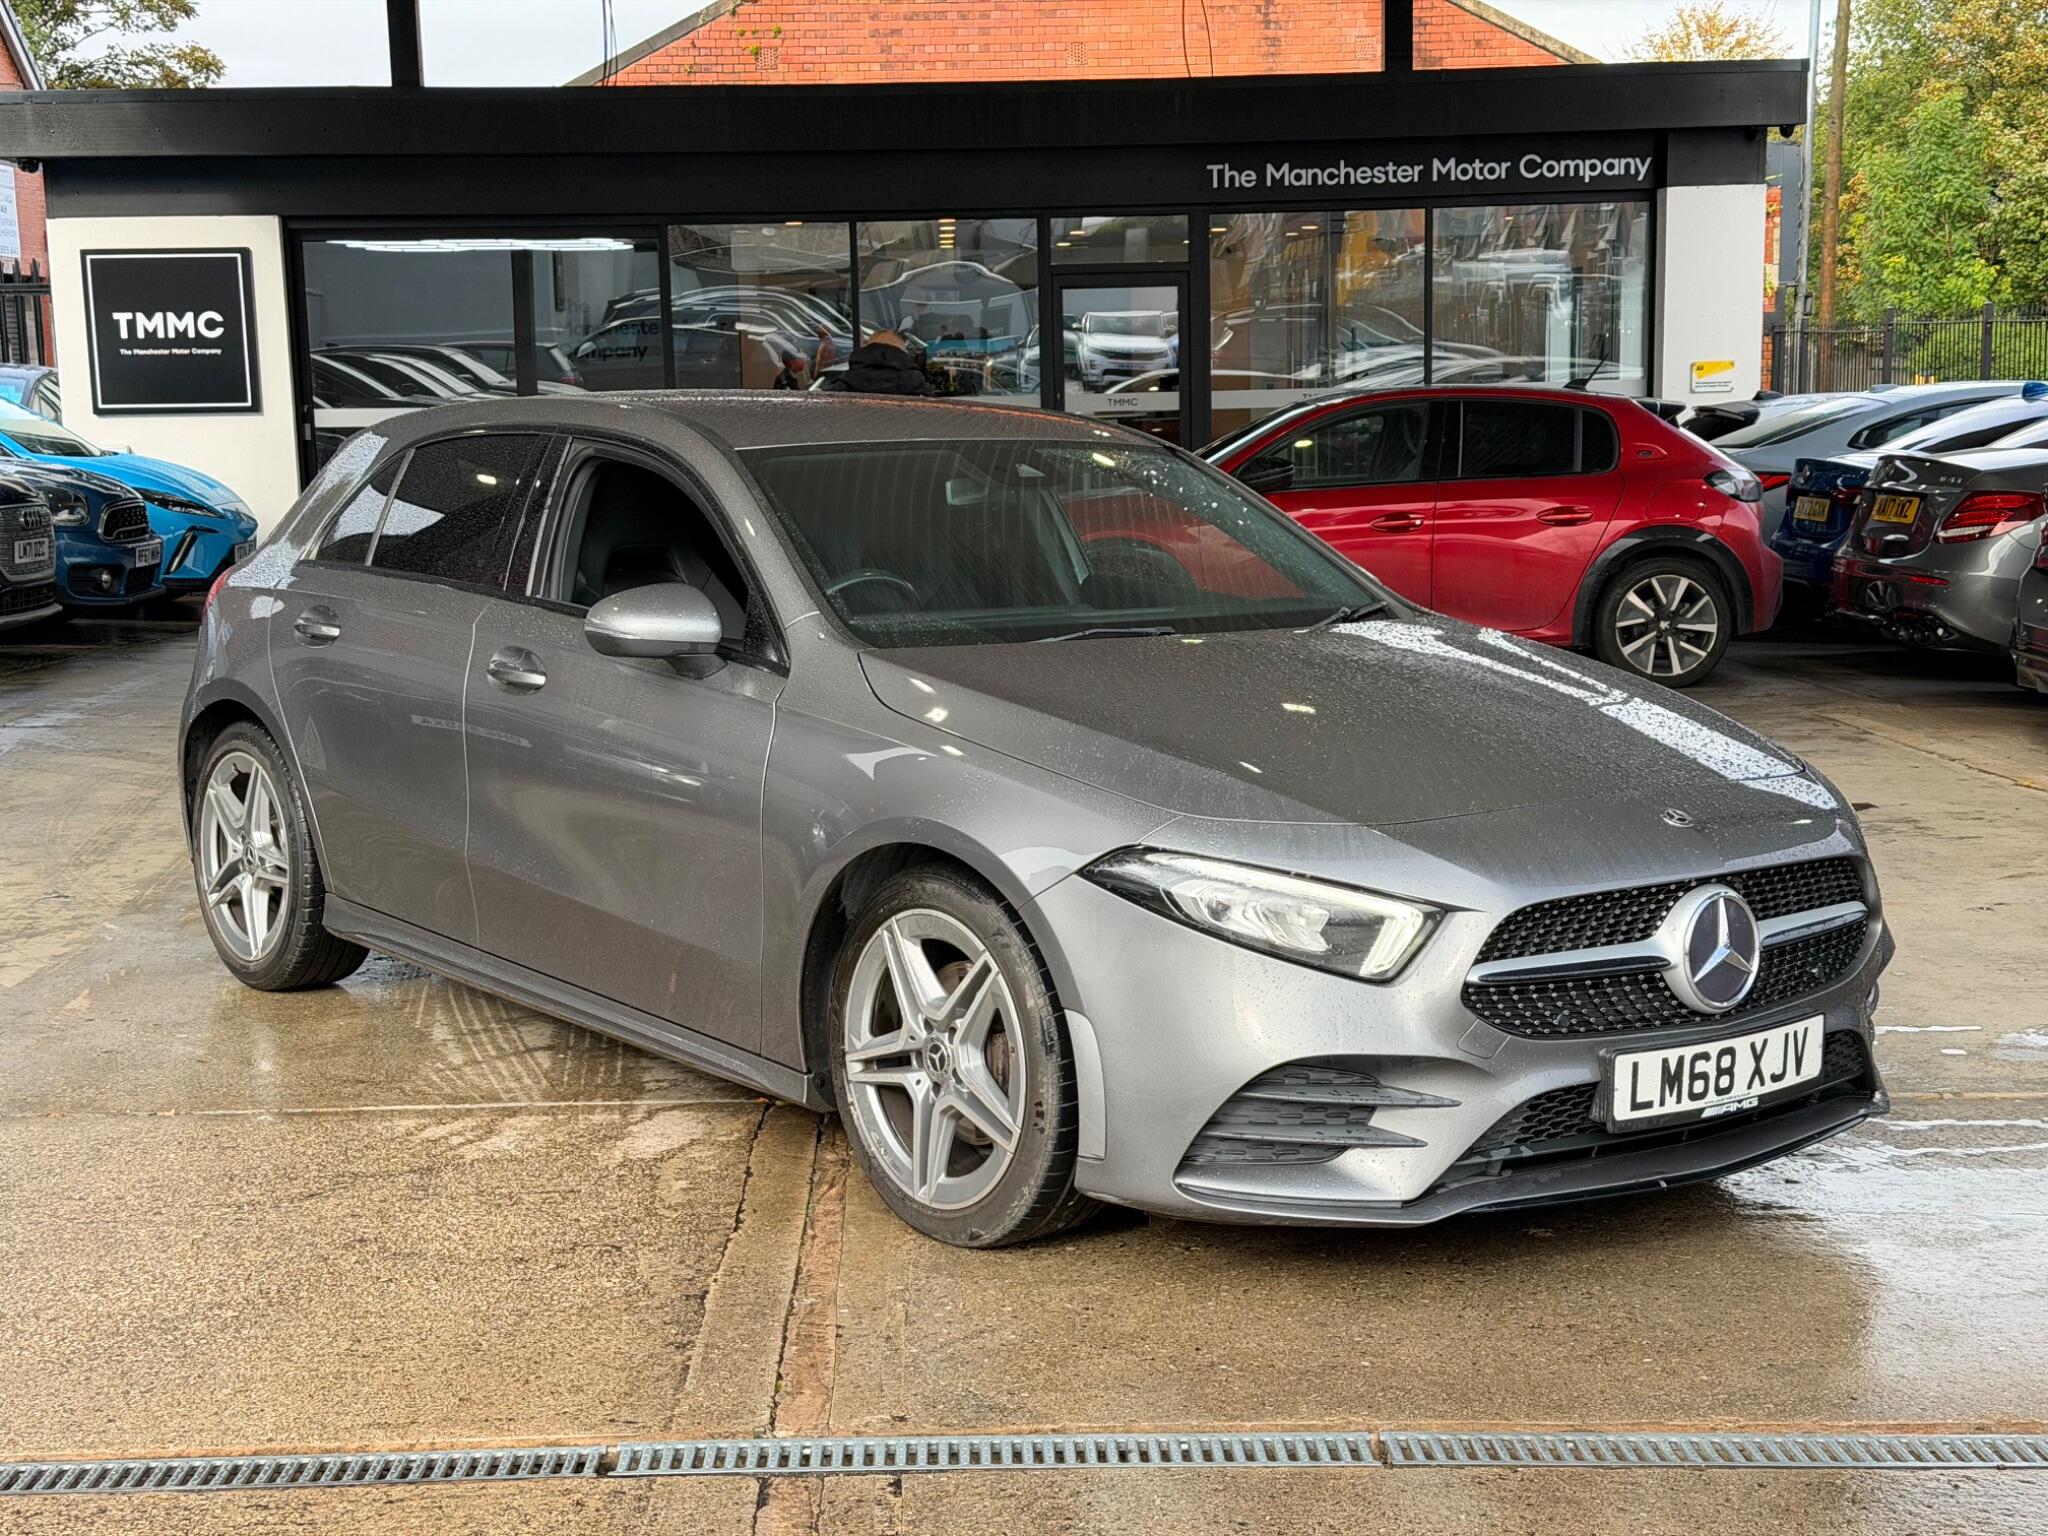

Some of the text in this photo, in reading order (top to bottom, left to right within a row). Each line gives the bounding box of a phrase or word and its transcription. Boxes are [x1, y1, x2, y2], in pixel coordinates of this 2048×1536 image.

[1206, 154, 1652, 188] The Manchester Motor Company
[112, 311, 225, 339] TMMC
[120, 347, 222, 356] The Manchester Motor Company
[1107, 398, 1139, 407] TMMC
[1630, 1026, 1809, 1112] LM68 XJV
[1720, 1096, 1759, 1114] AMG
